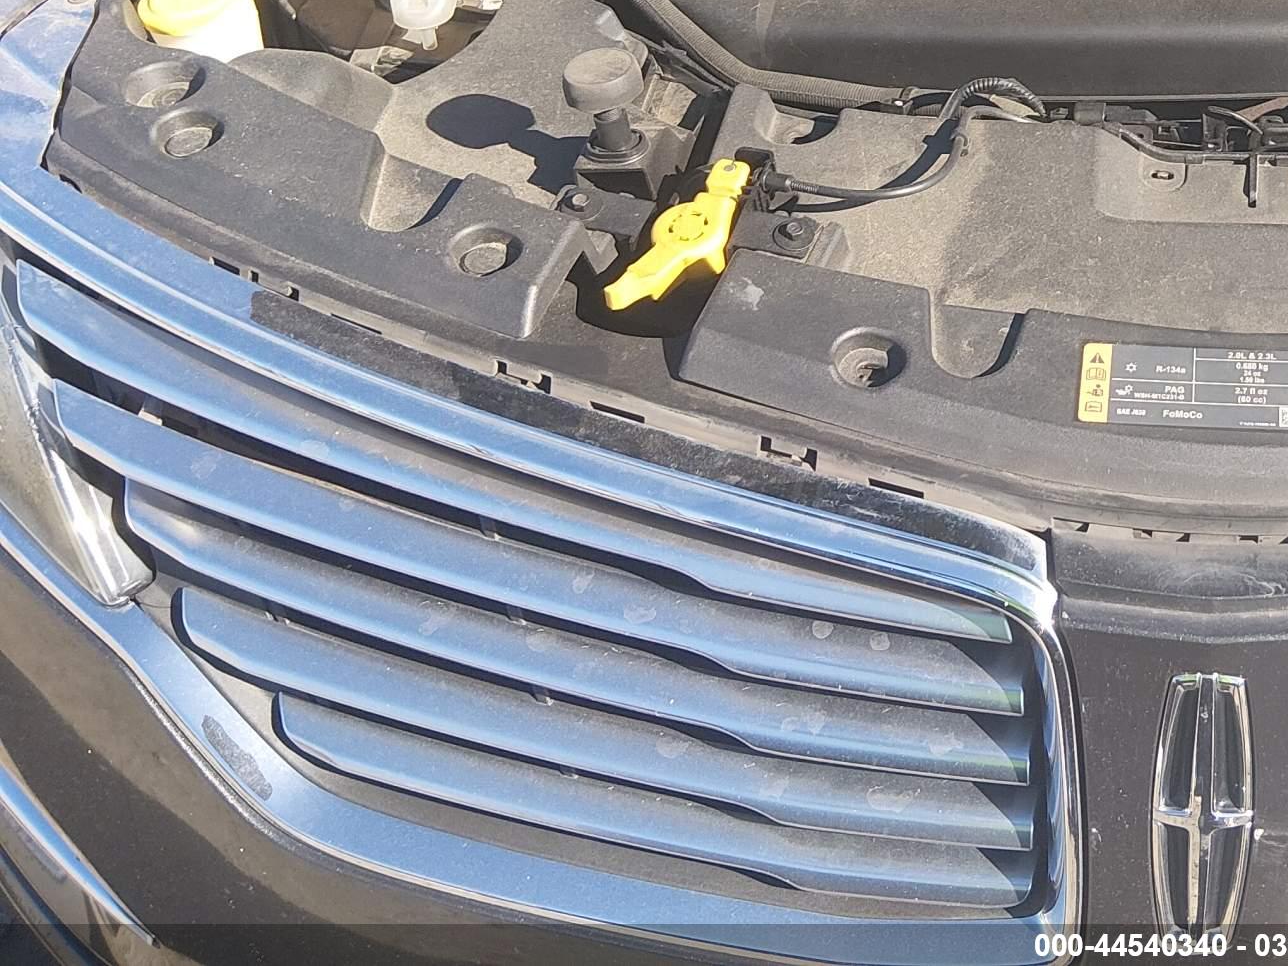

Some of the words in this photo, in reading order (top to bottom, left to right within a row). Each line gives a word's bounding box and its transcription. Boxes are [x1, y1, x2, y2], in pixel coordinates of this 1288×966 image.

[1155, 364, 1187, 375] R-134a
[1258, 362, 1269, 372] kg
[1164, 385, 1185, 394] PAG
[1234, 387, 1248, 395] 2.7
[1252, 396, 1267, 405] cc)
[1162, 409, 1204, 420] FoMoCo
